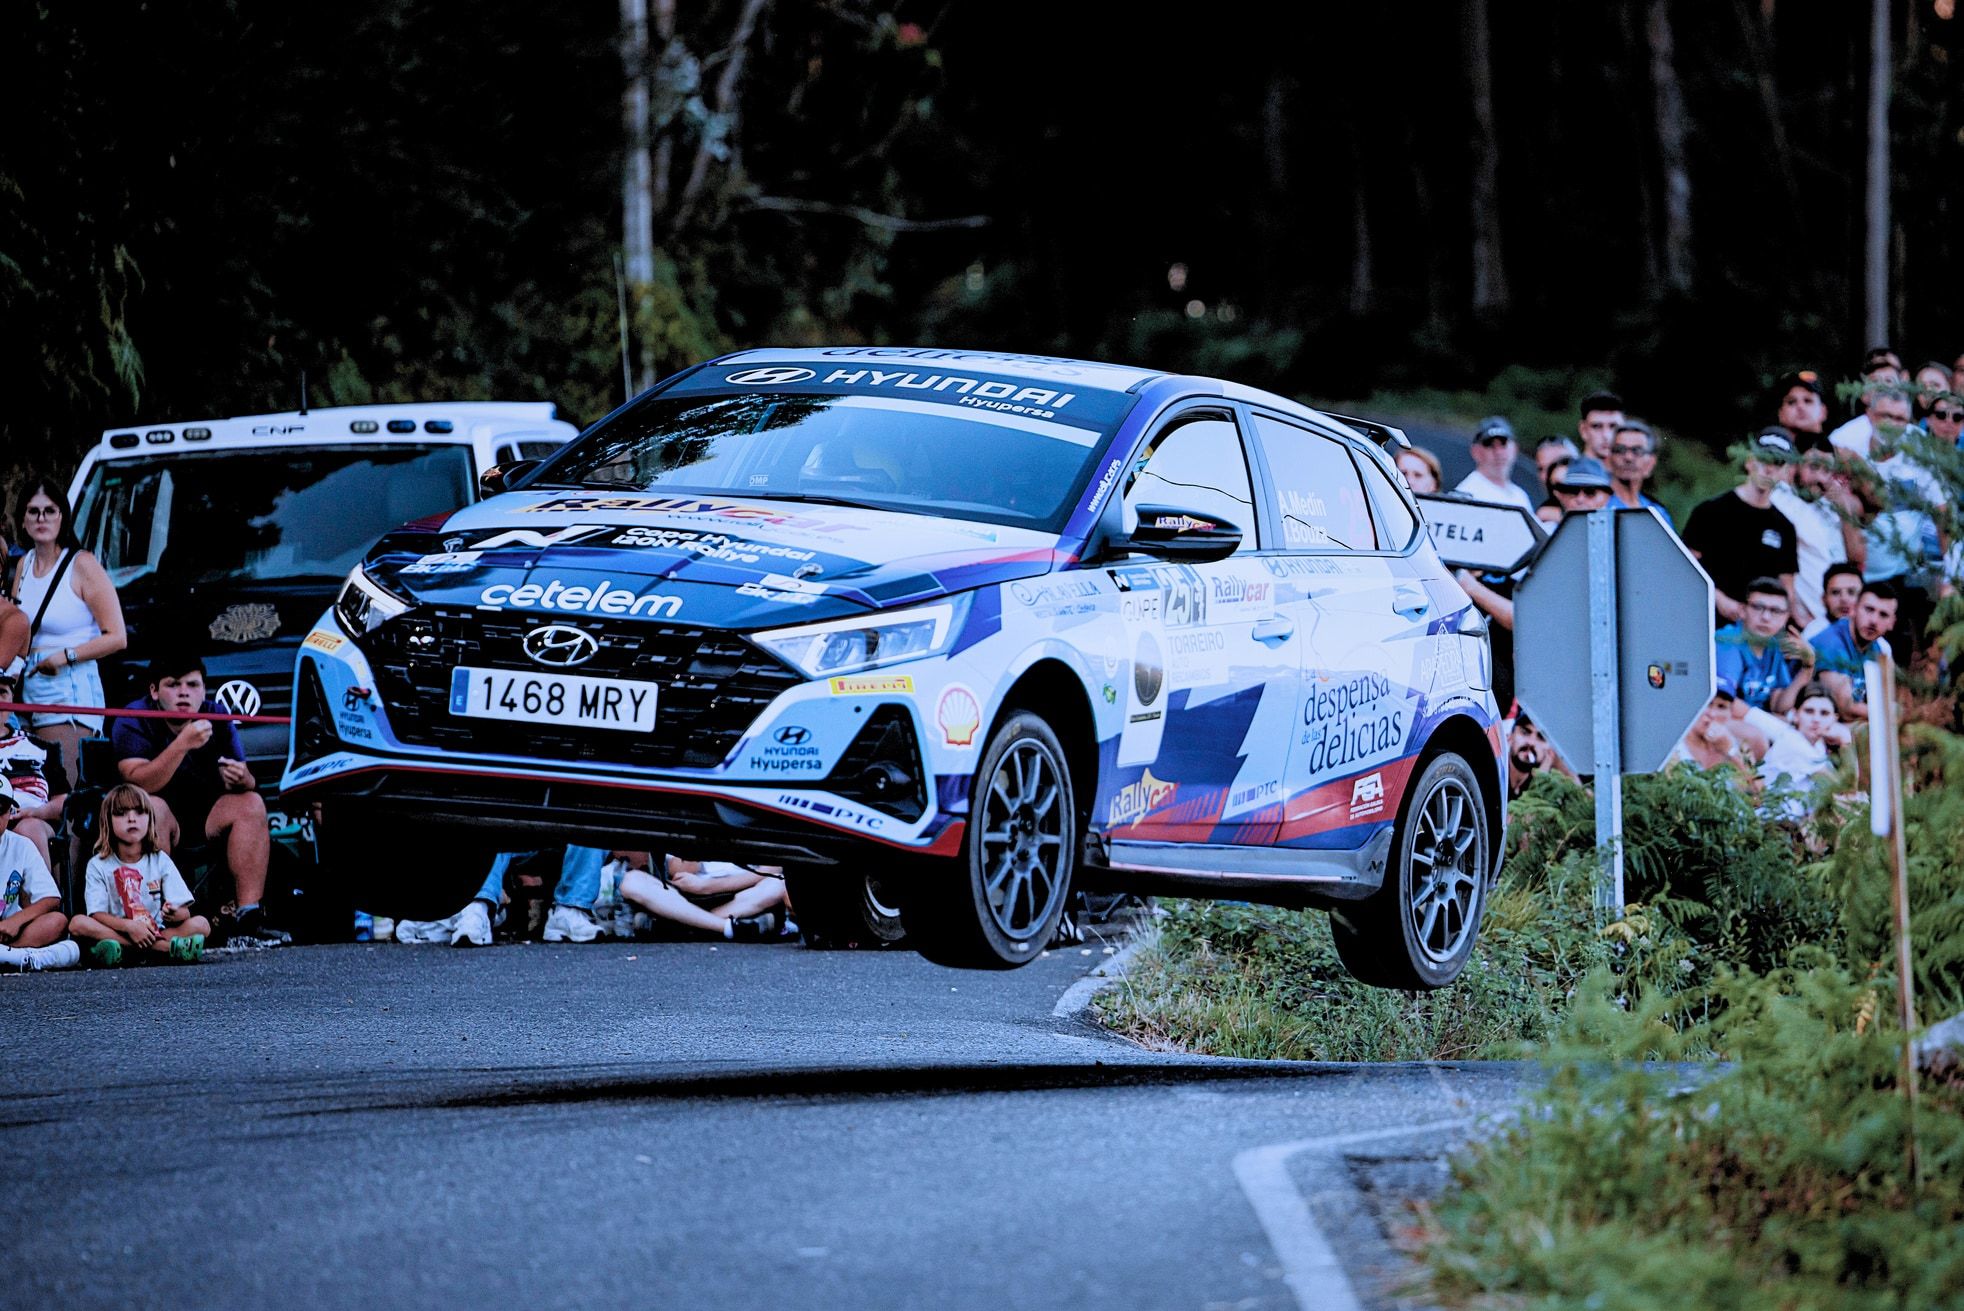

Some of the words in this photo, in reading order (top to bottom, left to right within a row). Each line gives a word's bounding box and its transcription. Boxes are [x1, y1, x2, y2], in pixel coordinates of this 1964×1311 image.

[822, 368, 1076, 408] HYUNDAI
[959, 395, 1055, 419] Hyupersa
[626, 527, 699, 541] Copa
[700, 533, 816, 562] Hyundai
[1427, 522, 1484, 543] TELA
[678, 541, 760, 563] Rallye
[480, 579, 684, 617] cetelem
[1211, 574, 1270, 603] Rallycar
[1167, 631, 1224, 655] TORREIRO
[483, 676, 566, 715] 1468
[578, 684, 647, 723] MRY
[1304, 672, 1390, 726] despensa
[764, 747, 819, 755] HYUNDAI
[1309, 704, 1402, 775] delicias
[750, 757, 822, 772] Hyupersa
[1112, 782, 1181, 820] Rallycar
[1256, 780, 1278, 799] PTC
[834, 807, 884, 830] PTC
